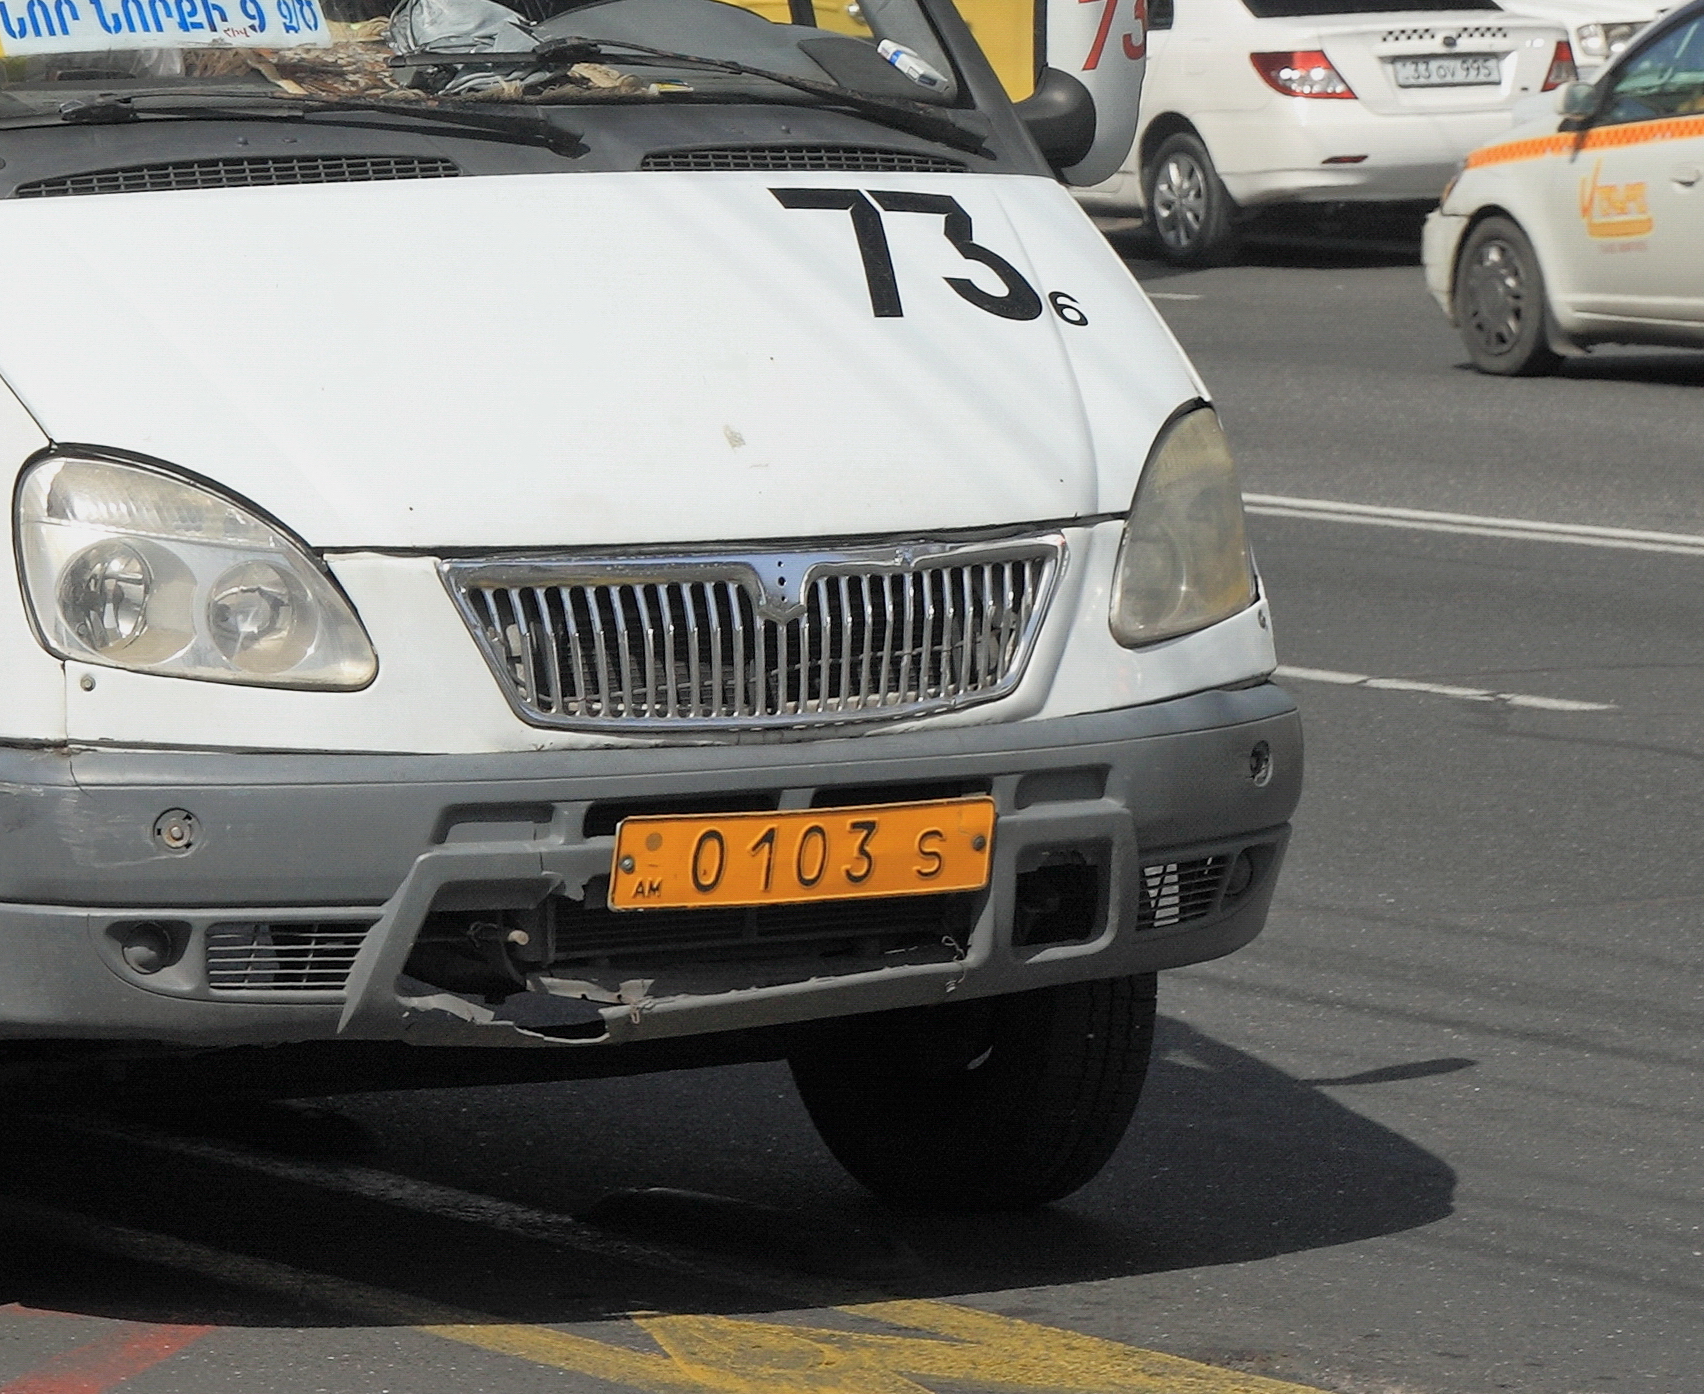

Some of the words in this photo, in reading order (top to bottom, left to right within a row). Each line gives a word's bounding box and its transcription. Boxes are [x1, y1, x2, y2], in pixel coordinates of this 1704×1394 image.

[1409, 59, 1431, 79] 33
[1461, 57, 1492, 78] 995
[766, 187, 1043, 321] 73
[1049, 291, 1089, 326] 6
[689, 819, 879, 894] 0103
[902, 828, 946, 878] S
[633, 880, 662, 898] AM
